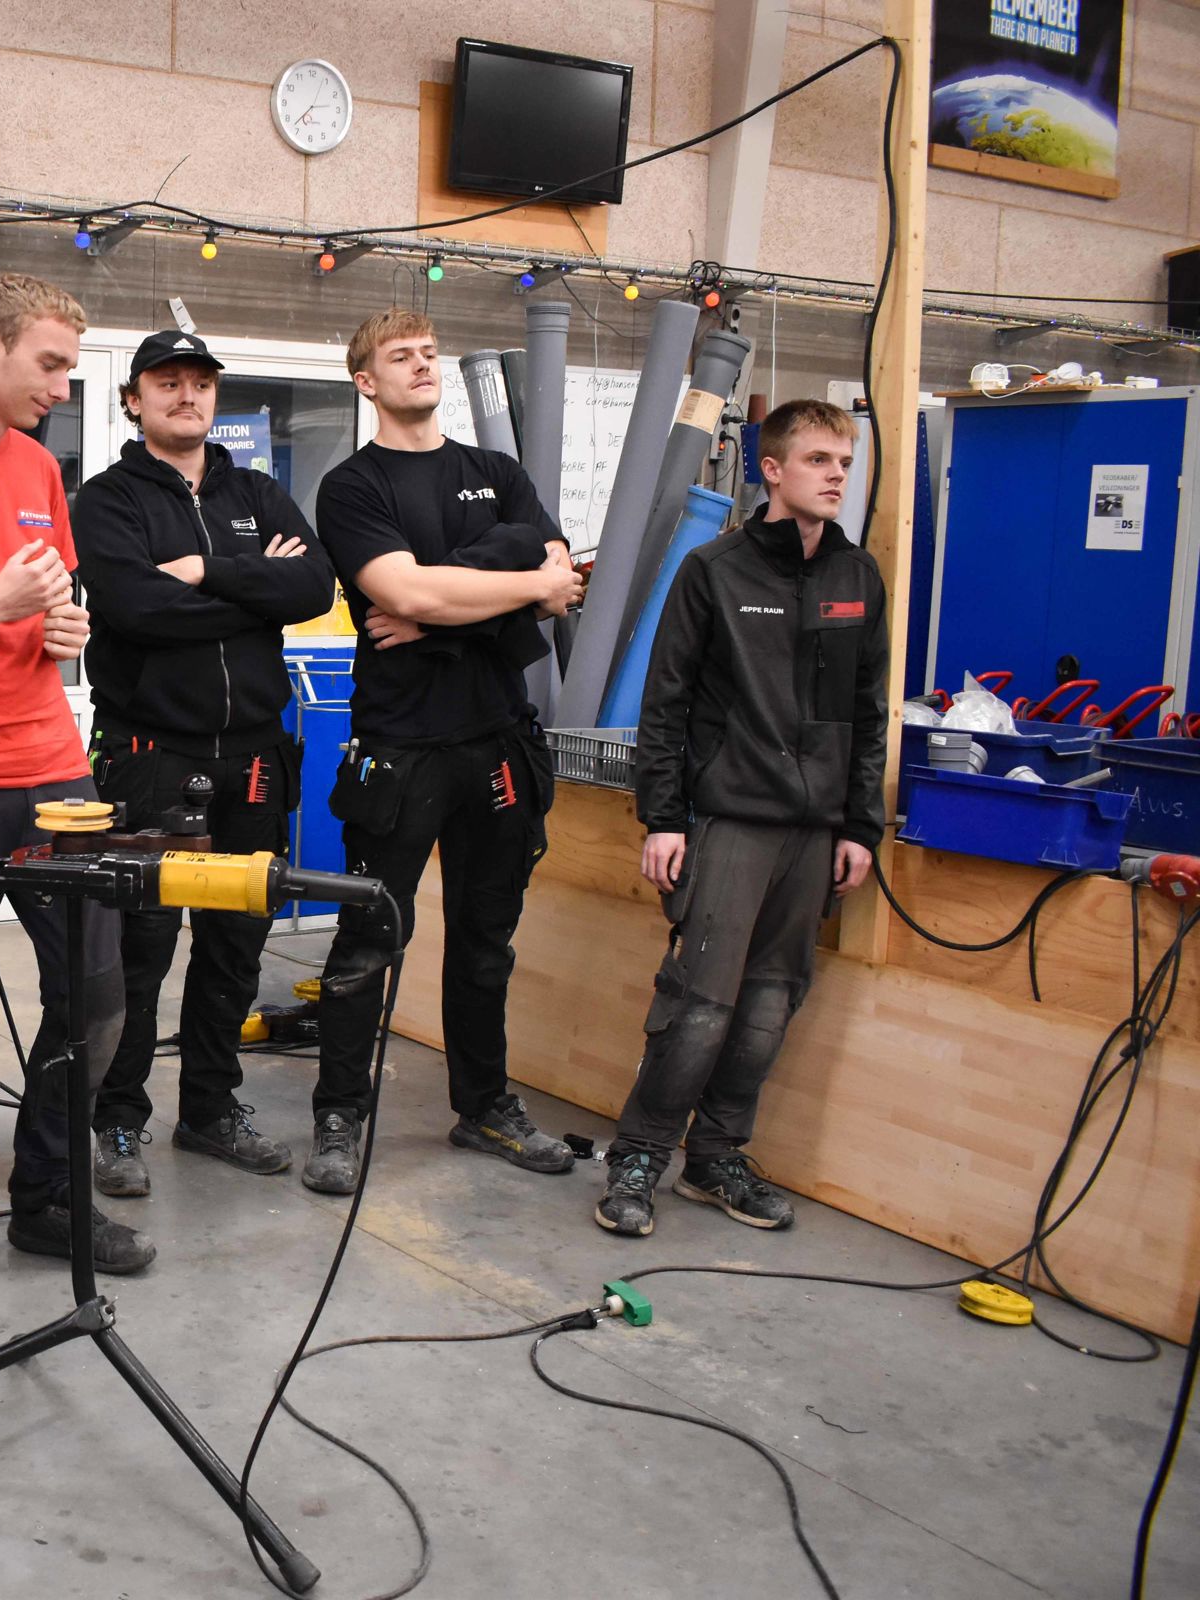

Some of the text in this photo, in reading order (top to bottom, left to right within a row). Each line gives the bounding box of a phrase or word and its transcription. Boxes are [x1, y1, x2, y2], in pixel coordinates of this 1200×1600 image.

[991, 0, 1078, 32] EMBER
[990, 15, 1077, 55] THERE IS NO PLANET B
[308, 69, 317, 78] 12
[286, 84, 295, 92] 10
[281, 99, 287, 107] 9
[336, 106, 341, 114] 3
[321, 132, 326, 140] 5
[214, 441, 255, 450] NDARIES
[1121, 520, 1133, 529] DS
[740, 605, 762, 613] JEPPE
